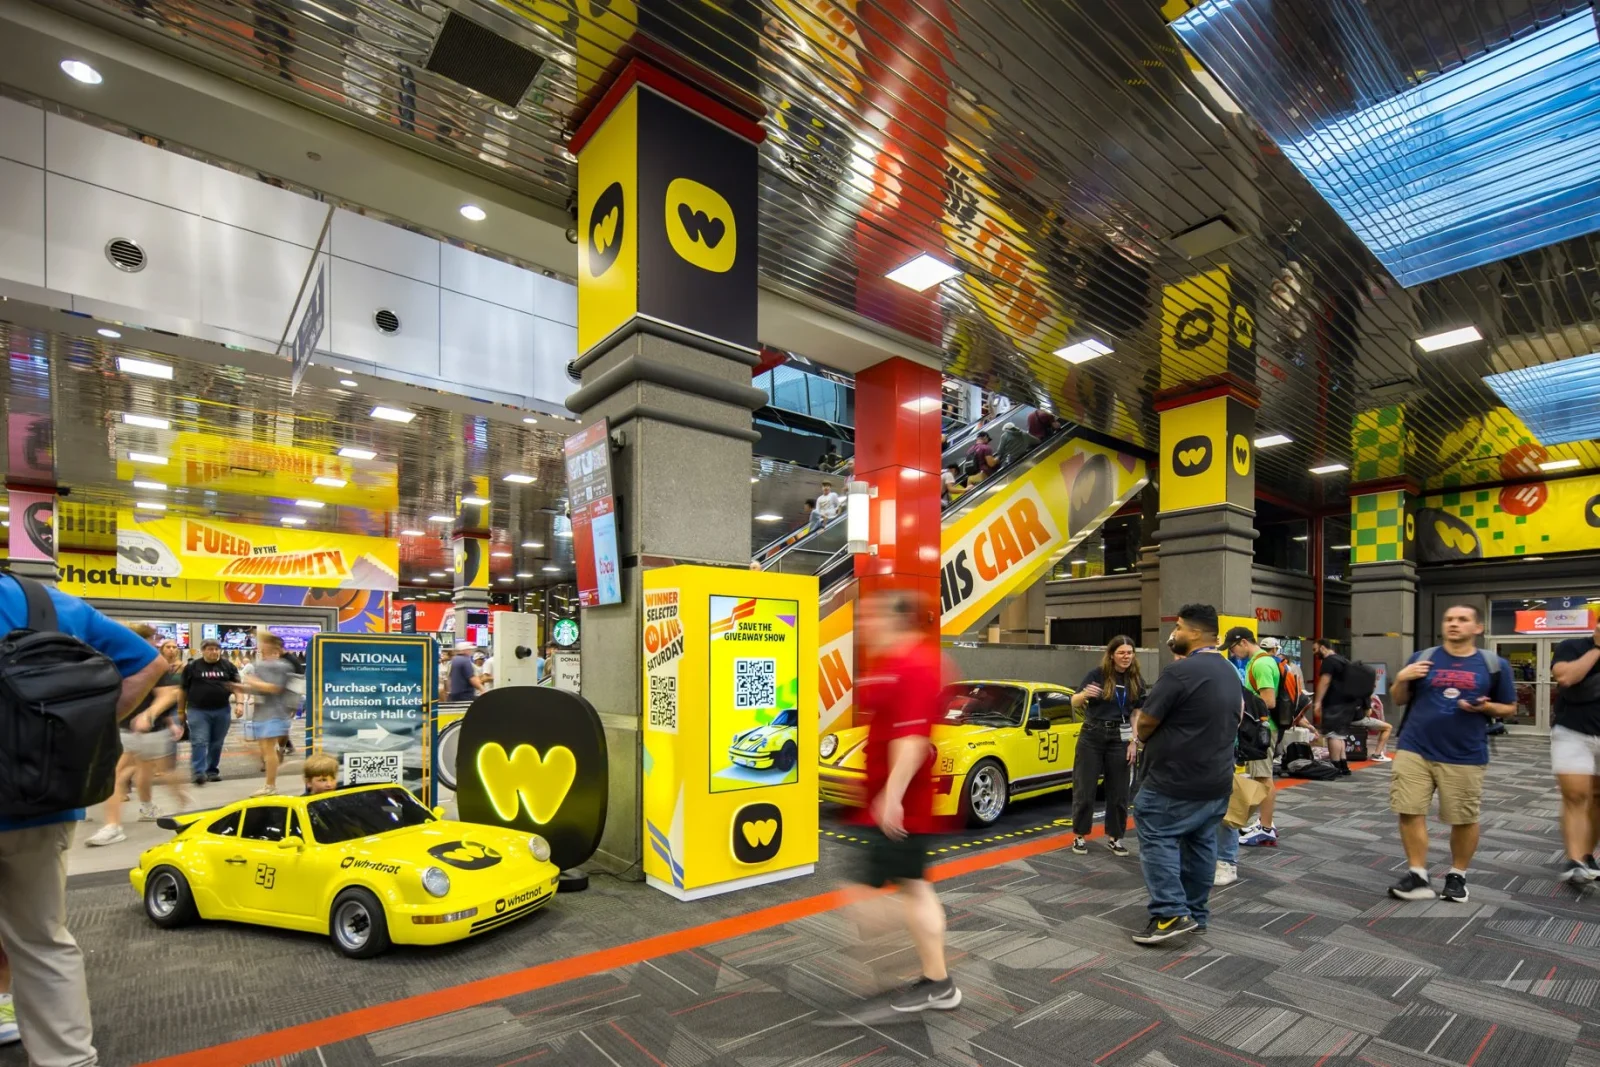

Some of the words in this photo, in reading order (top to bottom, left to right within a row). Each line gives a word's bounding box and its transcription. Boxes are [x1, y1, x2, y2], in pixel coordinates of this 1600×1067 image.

[186, 520, 251, 556] FUELED
[253, 547, 263, 555] BY
[263, 545, 277, 554] THE
[223, 550, 347, 576] COMMUNITY
[645, 591, 678, 607] WINNER
[818, 648, 853, 711] IN
[940, 549, 974, 616] HIS
[972, 497, 1052, 581] CAR
[646, 605, 678, 622] SELECTED
[1255, 607, 1283, 622] SECURITY
[659, 618, 682, 648] LIVE
[738, 622, 757, 631] SAVE
[758, 622, 773, 632] THE
[724, 632, 763, 642] GIVEAWAY
[764, 633, 786, 642] SHOW
[340, 652, 407, 664] NATIONAL
[646, 636, 684, 672] SATURDAY
[324, 683, 377, 693] Purchase
[380, 683, 422, 695] Today's
[323, 697, 382, 706] Admission
[385, 697, 423, 706] Tickets
[330, 710, 377, 722] Upstairs
[381, 709, 404, 719] Hall
[407, 710, 417, 719] G
[1038, 730, 1059, 763] 26
[941, 757, 954, 772] 26
[353, 857, 401, 875] whatnot
[254, 863, 276, 889] 26
[507, 885, 542, 907] whatnot
